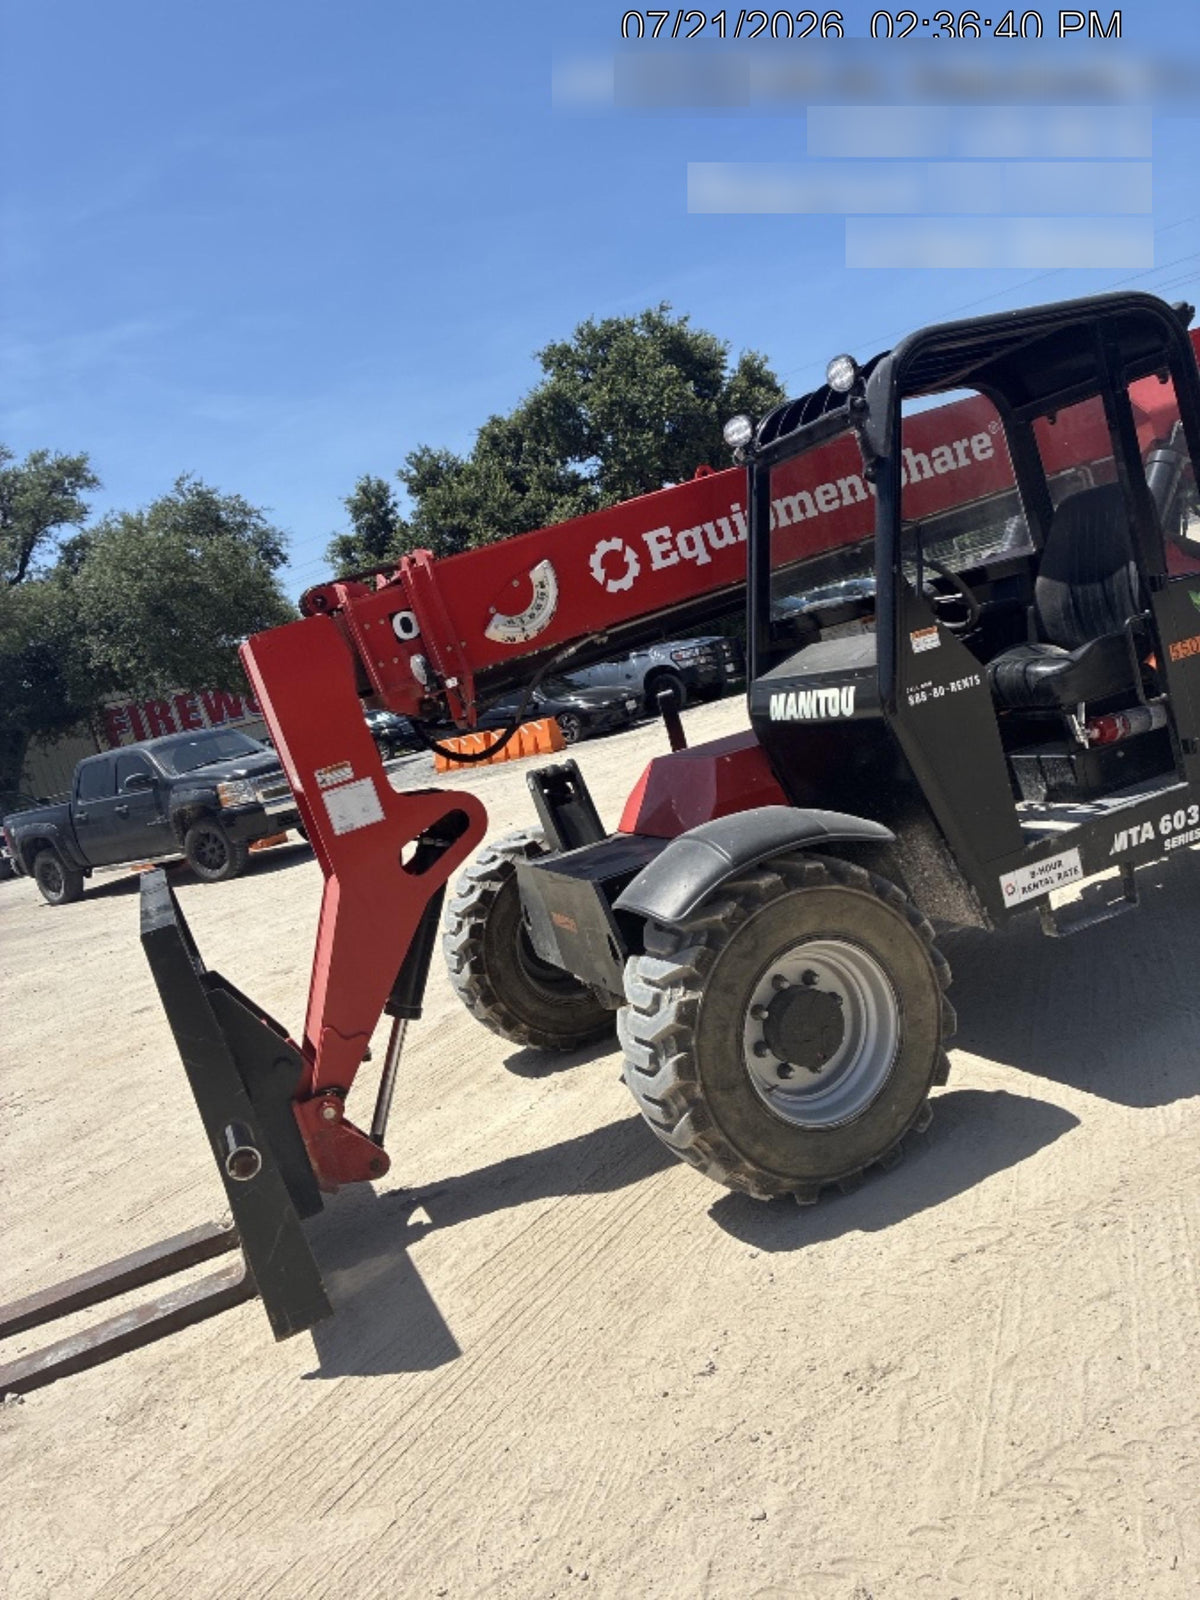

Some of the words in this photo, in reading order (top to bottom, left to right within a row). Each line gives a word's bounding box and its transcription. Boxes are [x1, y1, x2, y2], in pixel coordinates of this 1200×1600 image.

[769, 686, 856, 721] MANITOU
[1109, 821, 1156, 856] MTA
[1159, 804, 1200, 835] 603
[1021, 877, 1055, 895] RENTAL
[1057, 864, 1080, 882] RATE
